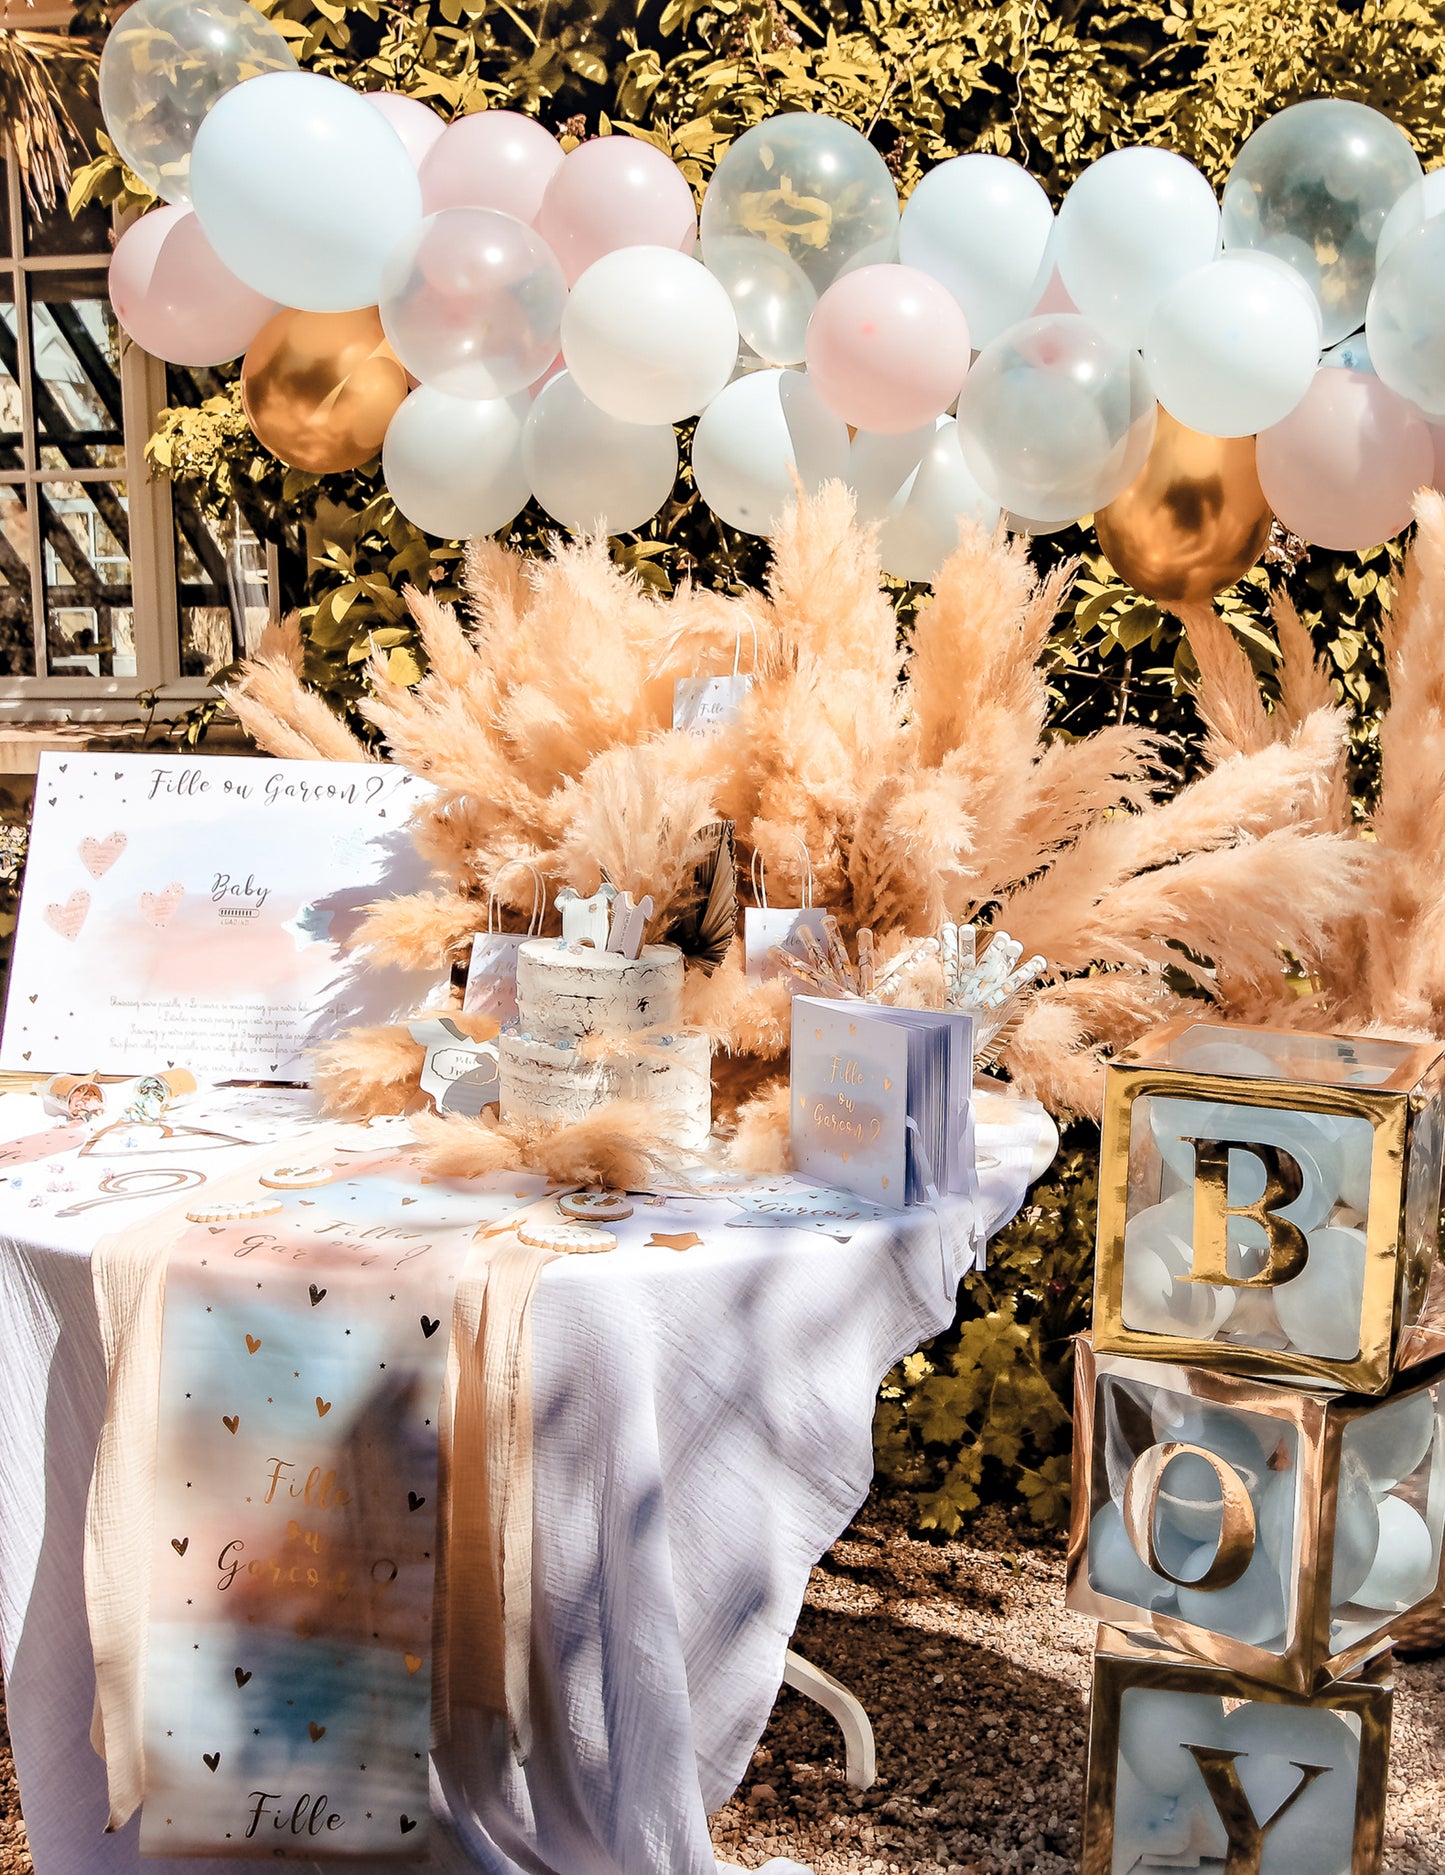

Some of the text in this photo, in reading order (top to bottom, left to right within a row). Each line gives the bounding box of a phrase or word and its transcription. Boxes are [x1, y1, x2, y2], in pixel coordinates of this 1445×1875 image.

[700, 703, 725, 716] Fille
[148, 768, 212, 799] Fille
[223, 780, 254, 799] ou
[211, 873, 272, 908] Baby
[830, 1055, 864, 1086] Fille
[838, 1091, 855, 1113] ou
[265, 1457, 353, 1510] Fille
[286, 1519, 325, 1554] ou
[245, 1791, 346, 1839] Fille
